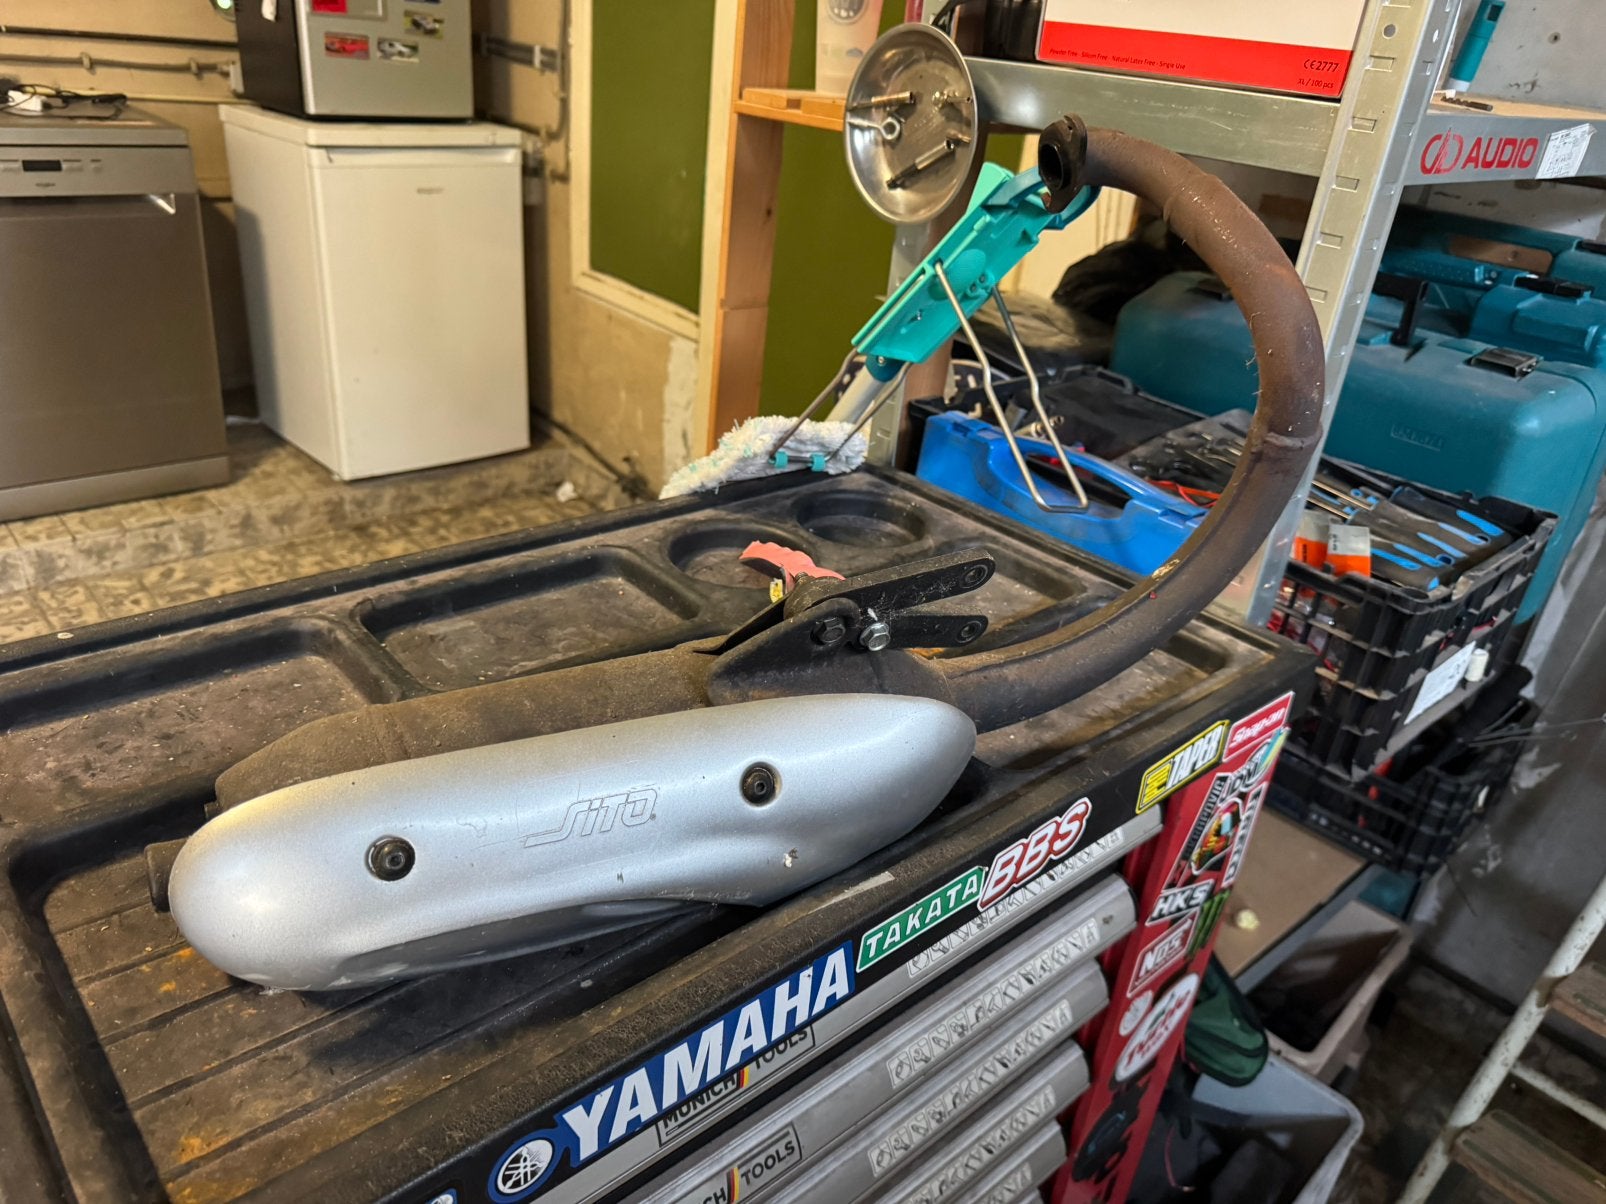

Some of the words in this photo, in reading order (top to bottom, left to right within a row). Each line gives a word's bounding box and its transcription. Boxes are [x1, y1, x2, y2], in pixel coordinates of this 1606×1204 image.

[1097, 53, 1108, 61] Free
[1112, 55, 1130, 63] Natural
[1143, 58, 1156, 66] Free
[1159, 60, 1175, 69] Single
[1176, 62, 1186, 70] Use
[1311, 79, 1323, 87] 100
[1461, 137, 1539, 170] AUDIO
[1166, 724, 1223, 790] TAPER
[980, 800, 1091, 908] BBS
[866, 874, 978, 958] TAKATA
[1151, 884, 1212, 918] HKS
[1139, 919, 1192, 978] NOS
[562, 947, 850, 1161] YAMAHA
[663, 1073, 736, 1129] MUNICH
[740, 1140, 796, 1186] TOOLS
